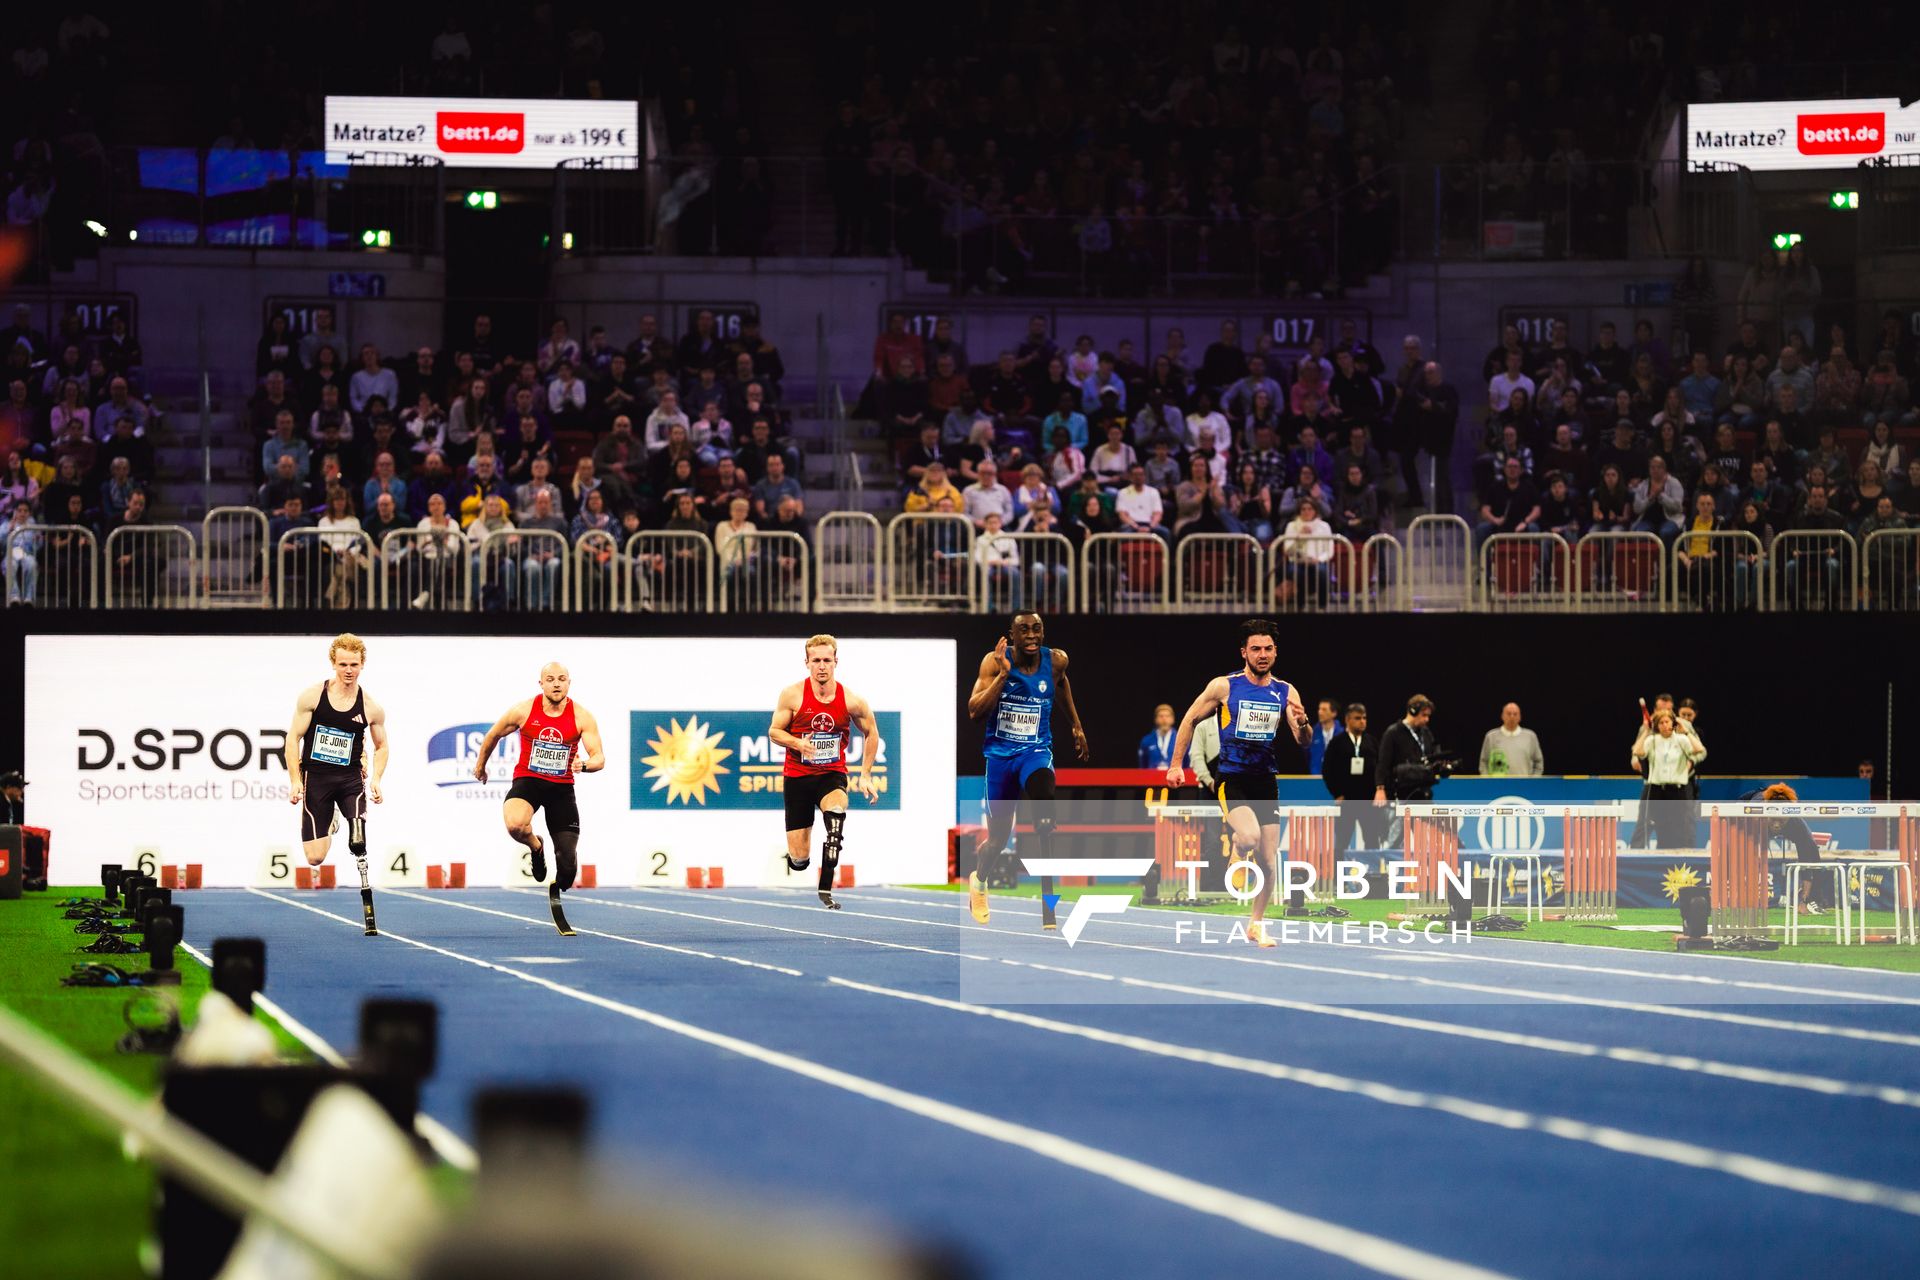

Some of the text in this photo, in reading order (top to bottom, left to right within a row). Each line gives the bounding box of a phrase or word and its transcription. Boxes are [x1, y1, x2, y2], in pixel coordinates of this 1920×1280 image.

[333, 123, 627, 147] Matratze? bett1.de nur ab 199 €
[1696, 125, 1915, 148] Matratze? bett1.de nur
[1273, 317, 1315, 344] 017
[1016, 713, 1038, 725] MANU
[1248, 711, 1271, 723] SHAW
[319, 734, 348, 749] DE JONG
[535, 748, 567, 761] BODELIER
[78, 779, 222, 805] Sportstadt
[137, 852, 156, 877] 6
[270, 854, 289, 879] 5
[390, 852, 410, 876] 4
[652, 852, 669, 876] 2
